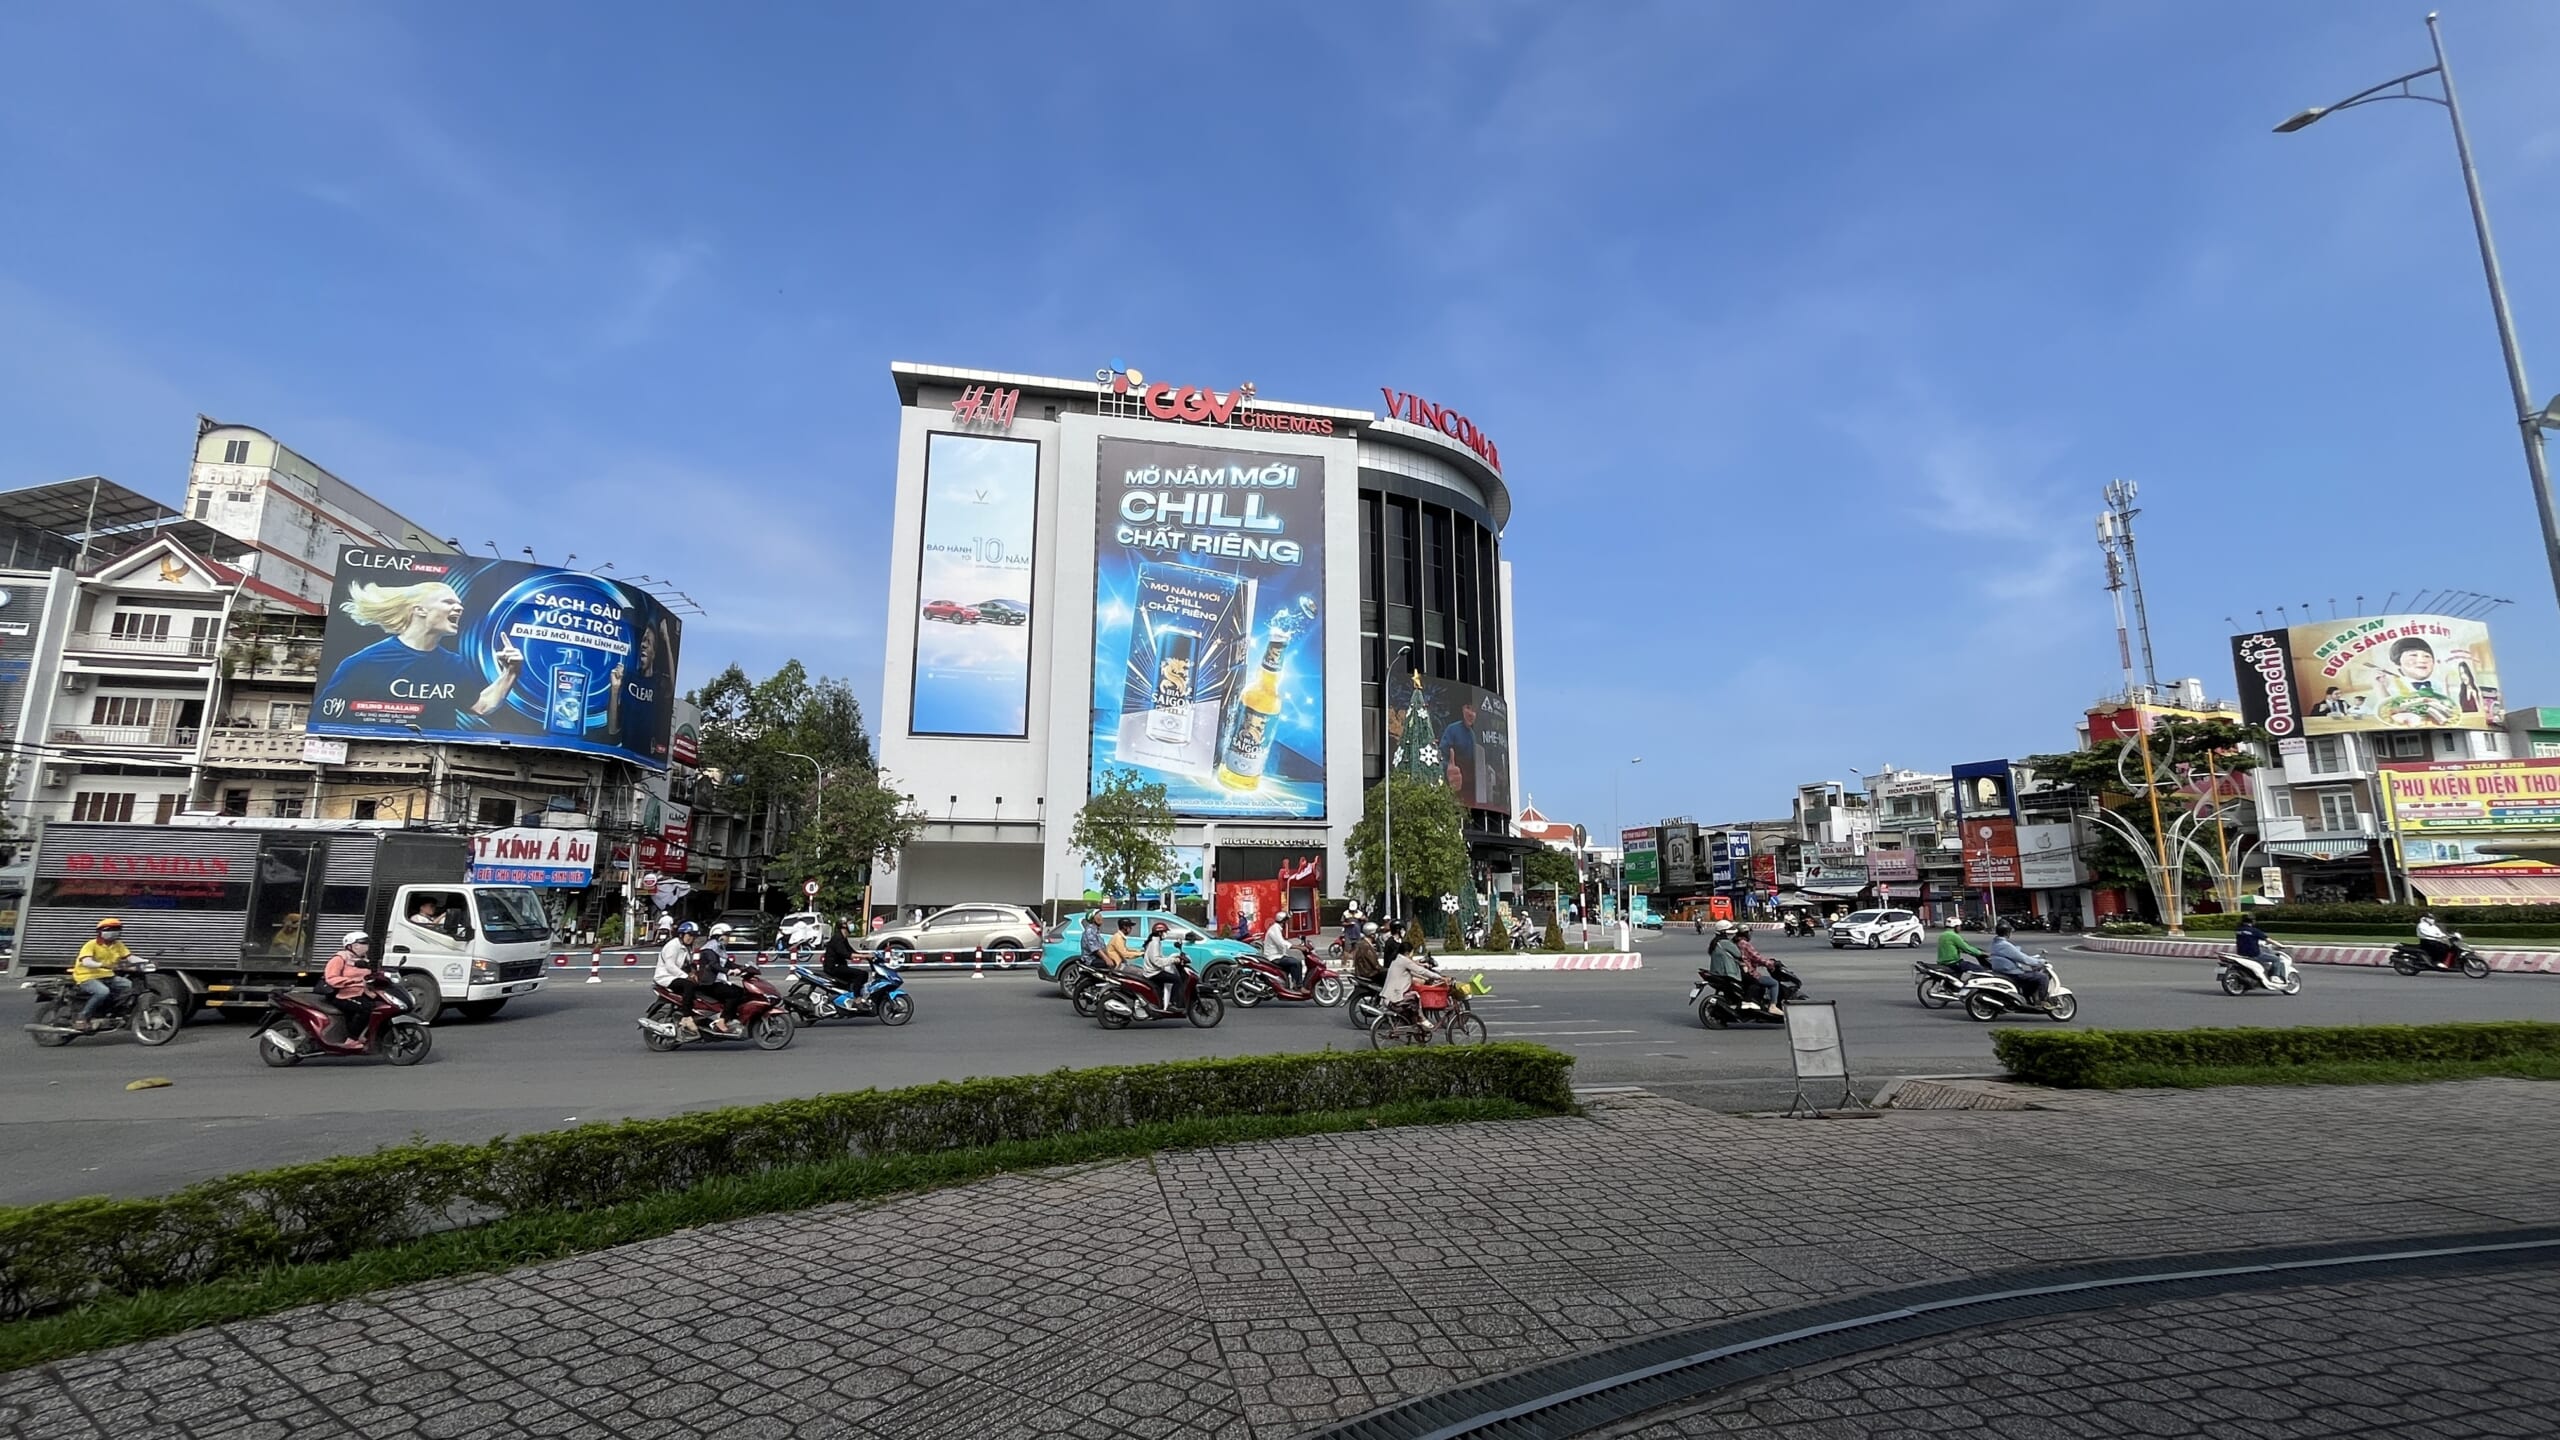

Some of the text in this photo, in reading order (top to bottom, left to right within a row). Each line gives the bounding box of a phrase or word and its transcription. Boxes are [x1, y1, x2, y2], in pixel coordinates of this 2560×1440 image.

[1096, 369, 1114, 383] CJ
[952, 385, 1019, 428] H&M
[1145, 381, 1334, 434] CGV CINEMAS
[1125, 462, 1298, 487] MỞ NĂM MỚI
[1120, 491, 1282, 531] CHILL
[1117, 526, 1302, 563] CHẤT RIÊNG
[345, 549, 442, 573] CLEAR MEN
[534, 593, 585, 612] SẠCH
[1166, 595, 1202, 609] CHILL
[533, 610, 581, 630] VƯỢT
[1182, 608, 1218, 622] RIÊNG
[2338, 629, 2358, 645] RA
[2358, 618, 2386, 634] TAY
[390, 678, 456, 699] CLEAR
[628, 683, 654, 702] CLEAR
[2254, 647, 2295, 736] Omachi
[1151, 692, 1194, 711] SAIGON
[2393, 778, 2425, 801] PHỤ
[2430, 773, 2472, 799] KIỆN
[2476, 772, 2518, 798] ĐIỆN
[495, 834, 542, 860] KÍNH
[547, 836, 561, 860] Á
[566, 837, 590, 862] ÂU
[1222, 837, 1280, 847] HIGHLANDS
